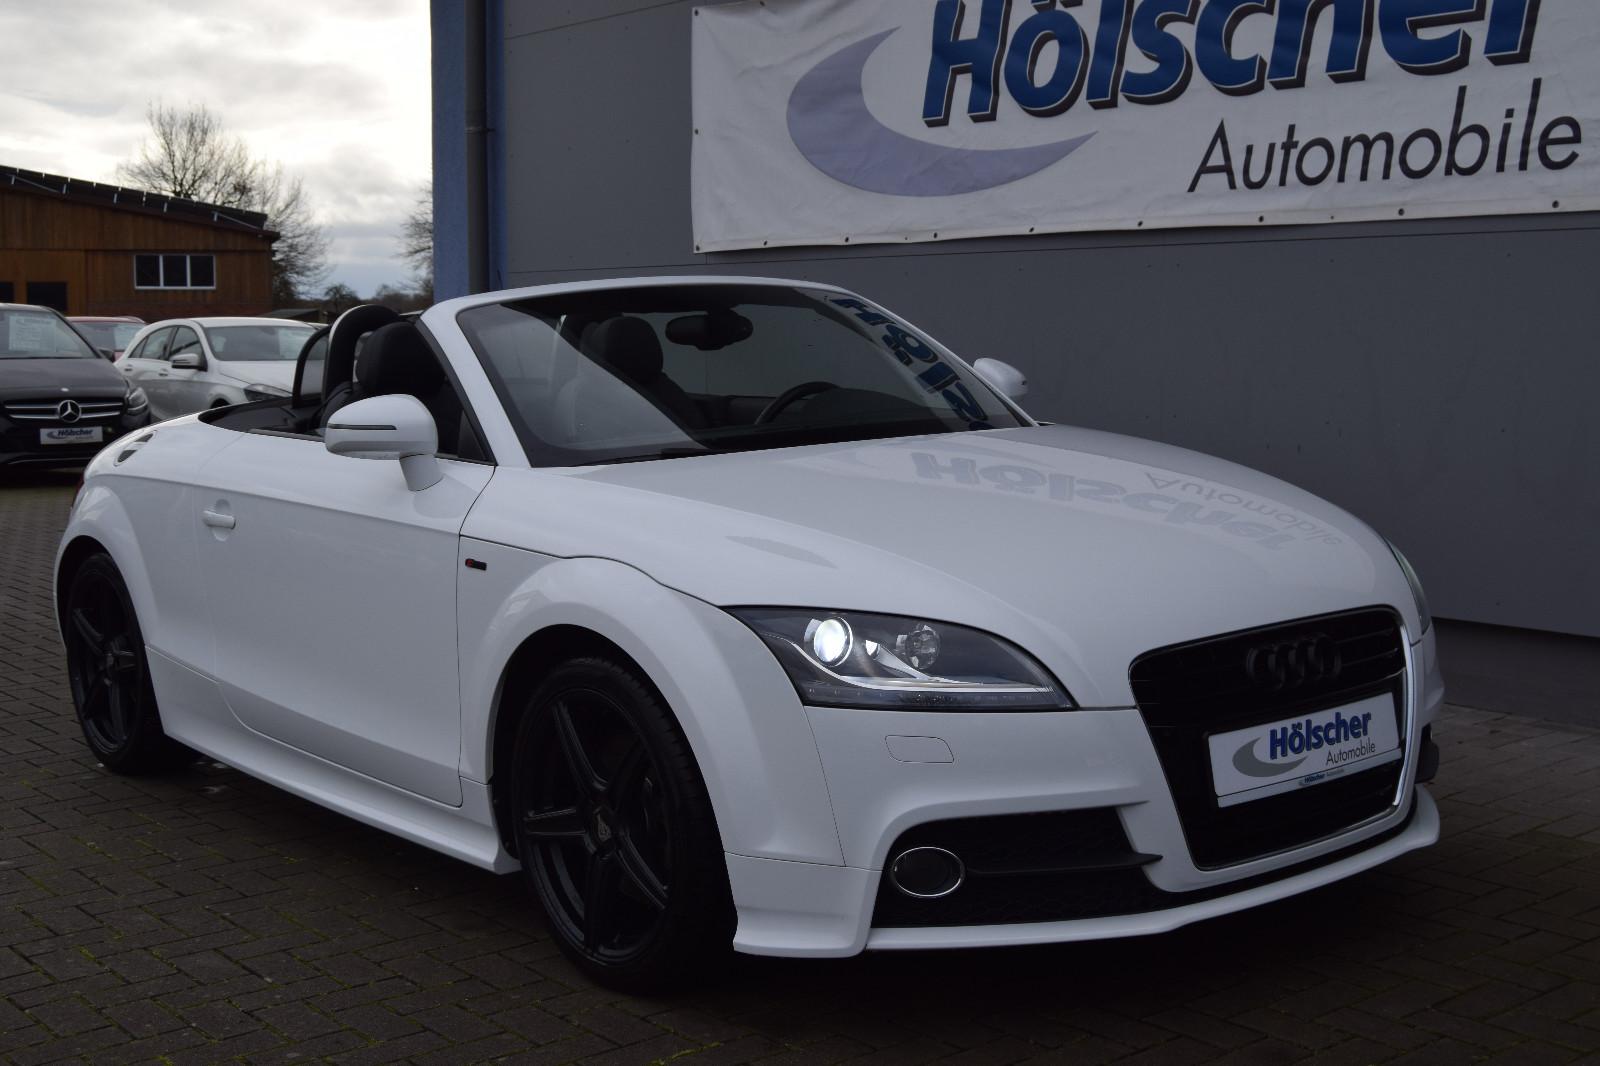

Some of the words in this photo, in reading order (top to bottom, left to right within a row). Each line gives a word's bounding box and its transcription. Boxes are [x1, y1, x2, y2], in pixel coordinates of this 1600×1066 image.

[1187, 78, 1582, 193] Automobile
[1269, 711, 1372, 760] Hölscher
[1325, 737, 1377, 766] Automobile
